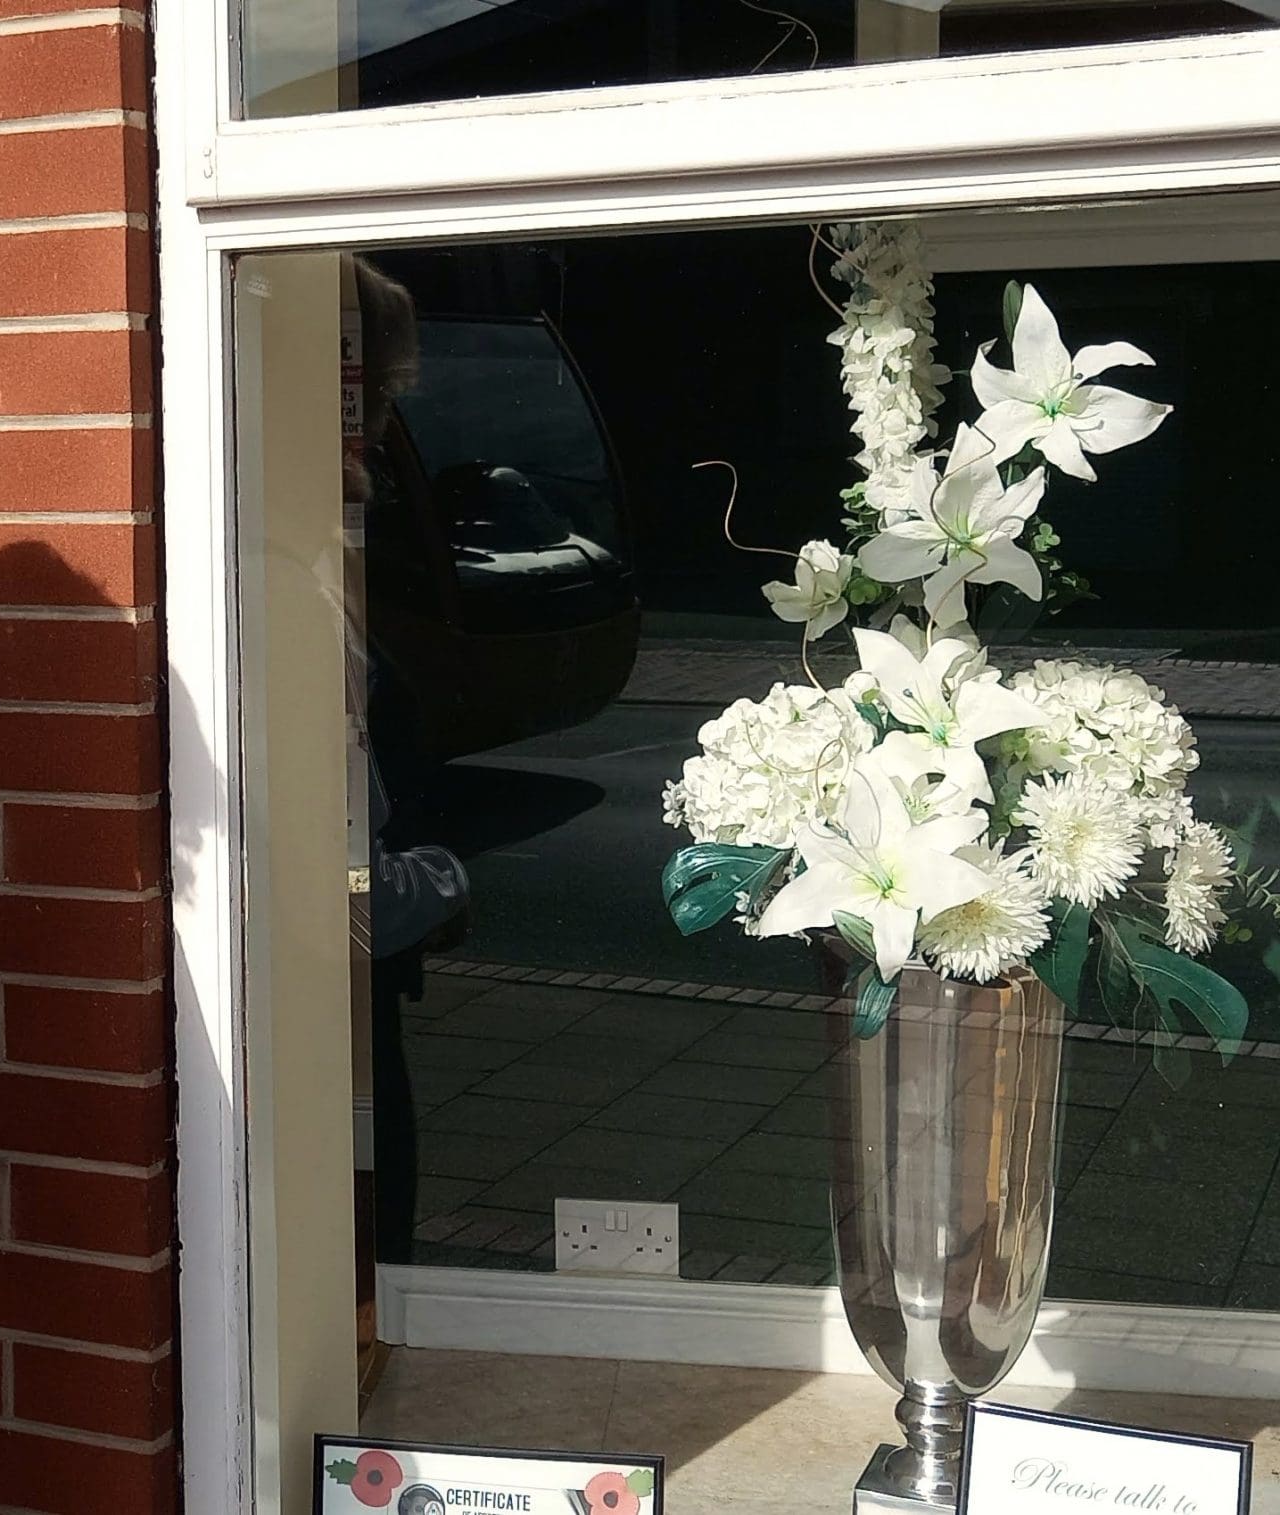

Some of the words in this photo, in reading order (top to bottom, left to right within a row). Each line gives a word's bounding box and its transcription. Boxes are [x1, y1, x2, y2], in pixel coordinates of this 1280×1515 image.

[446, 1488, 531, 1512] CERTIFICATE
[1011, 1457, 1108, 1501] Please
[1114, 1483, 1167, 1510] talk
[1173, 1495, 1199, 1515] to
